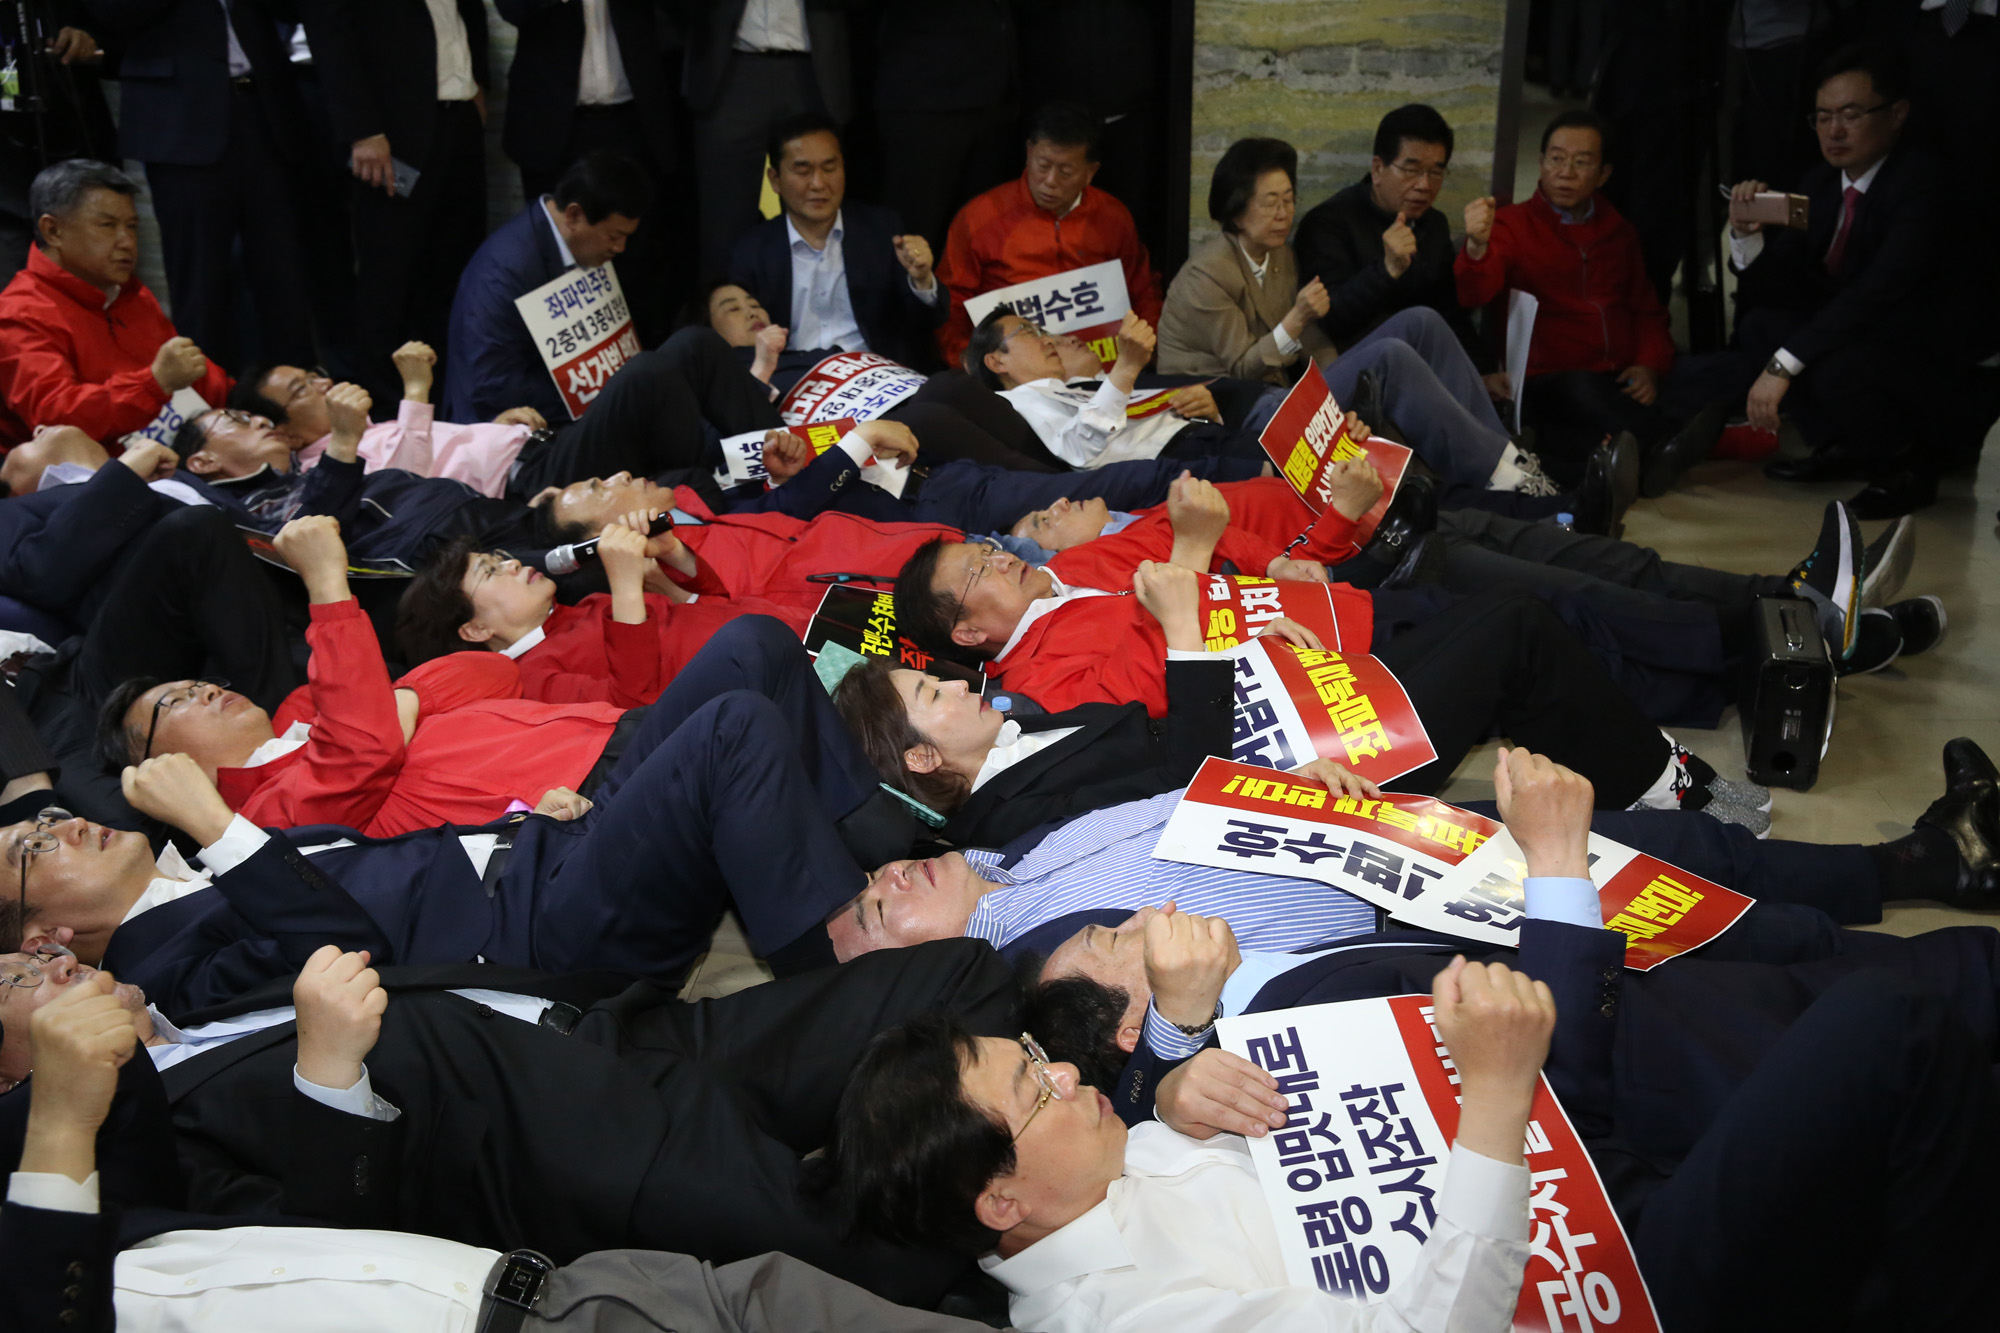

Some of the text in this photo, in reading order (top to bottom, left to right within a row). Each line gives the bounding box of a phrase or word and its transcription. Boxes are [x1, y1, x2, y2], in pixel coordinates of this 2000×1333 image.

[544, 267, 613, 320] 좌파민주당
[1008, 281, 1105, 327] 법수호
[546, 320, 591, 359] 2중대
[587, 304, 617, 336] 3중대
[1283, 436, 1319, 495] 대통령
[1306, 663, 1393, 766] 좌파독재
[1220, 774, 1328, 810] 반대!
[1624, 873, 1705, 926] 반대!
[1245, 1026, 1355, 1193] 입맛대로
[1339, 1082, 1439, 1246] 수사조작
